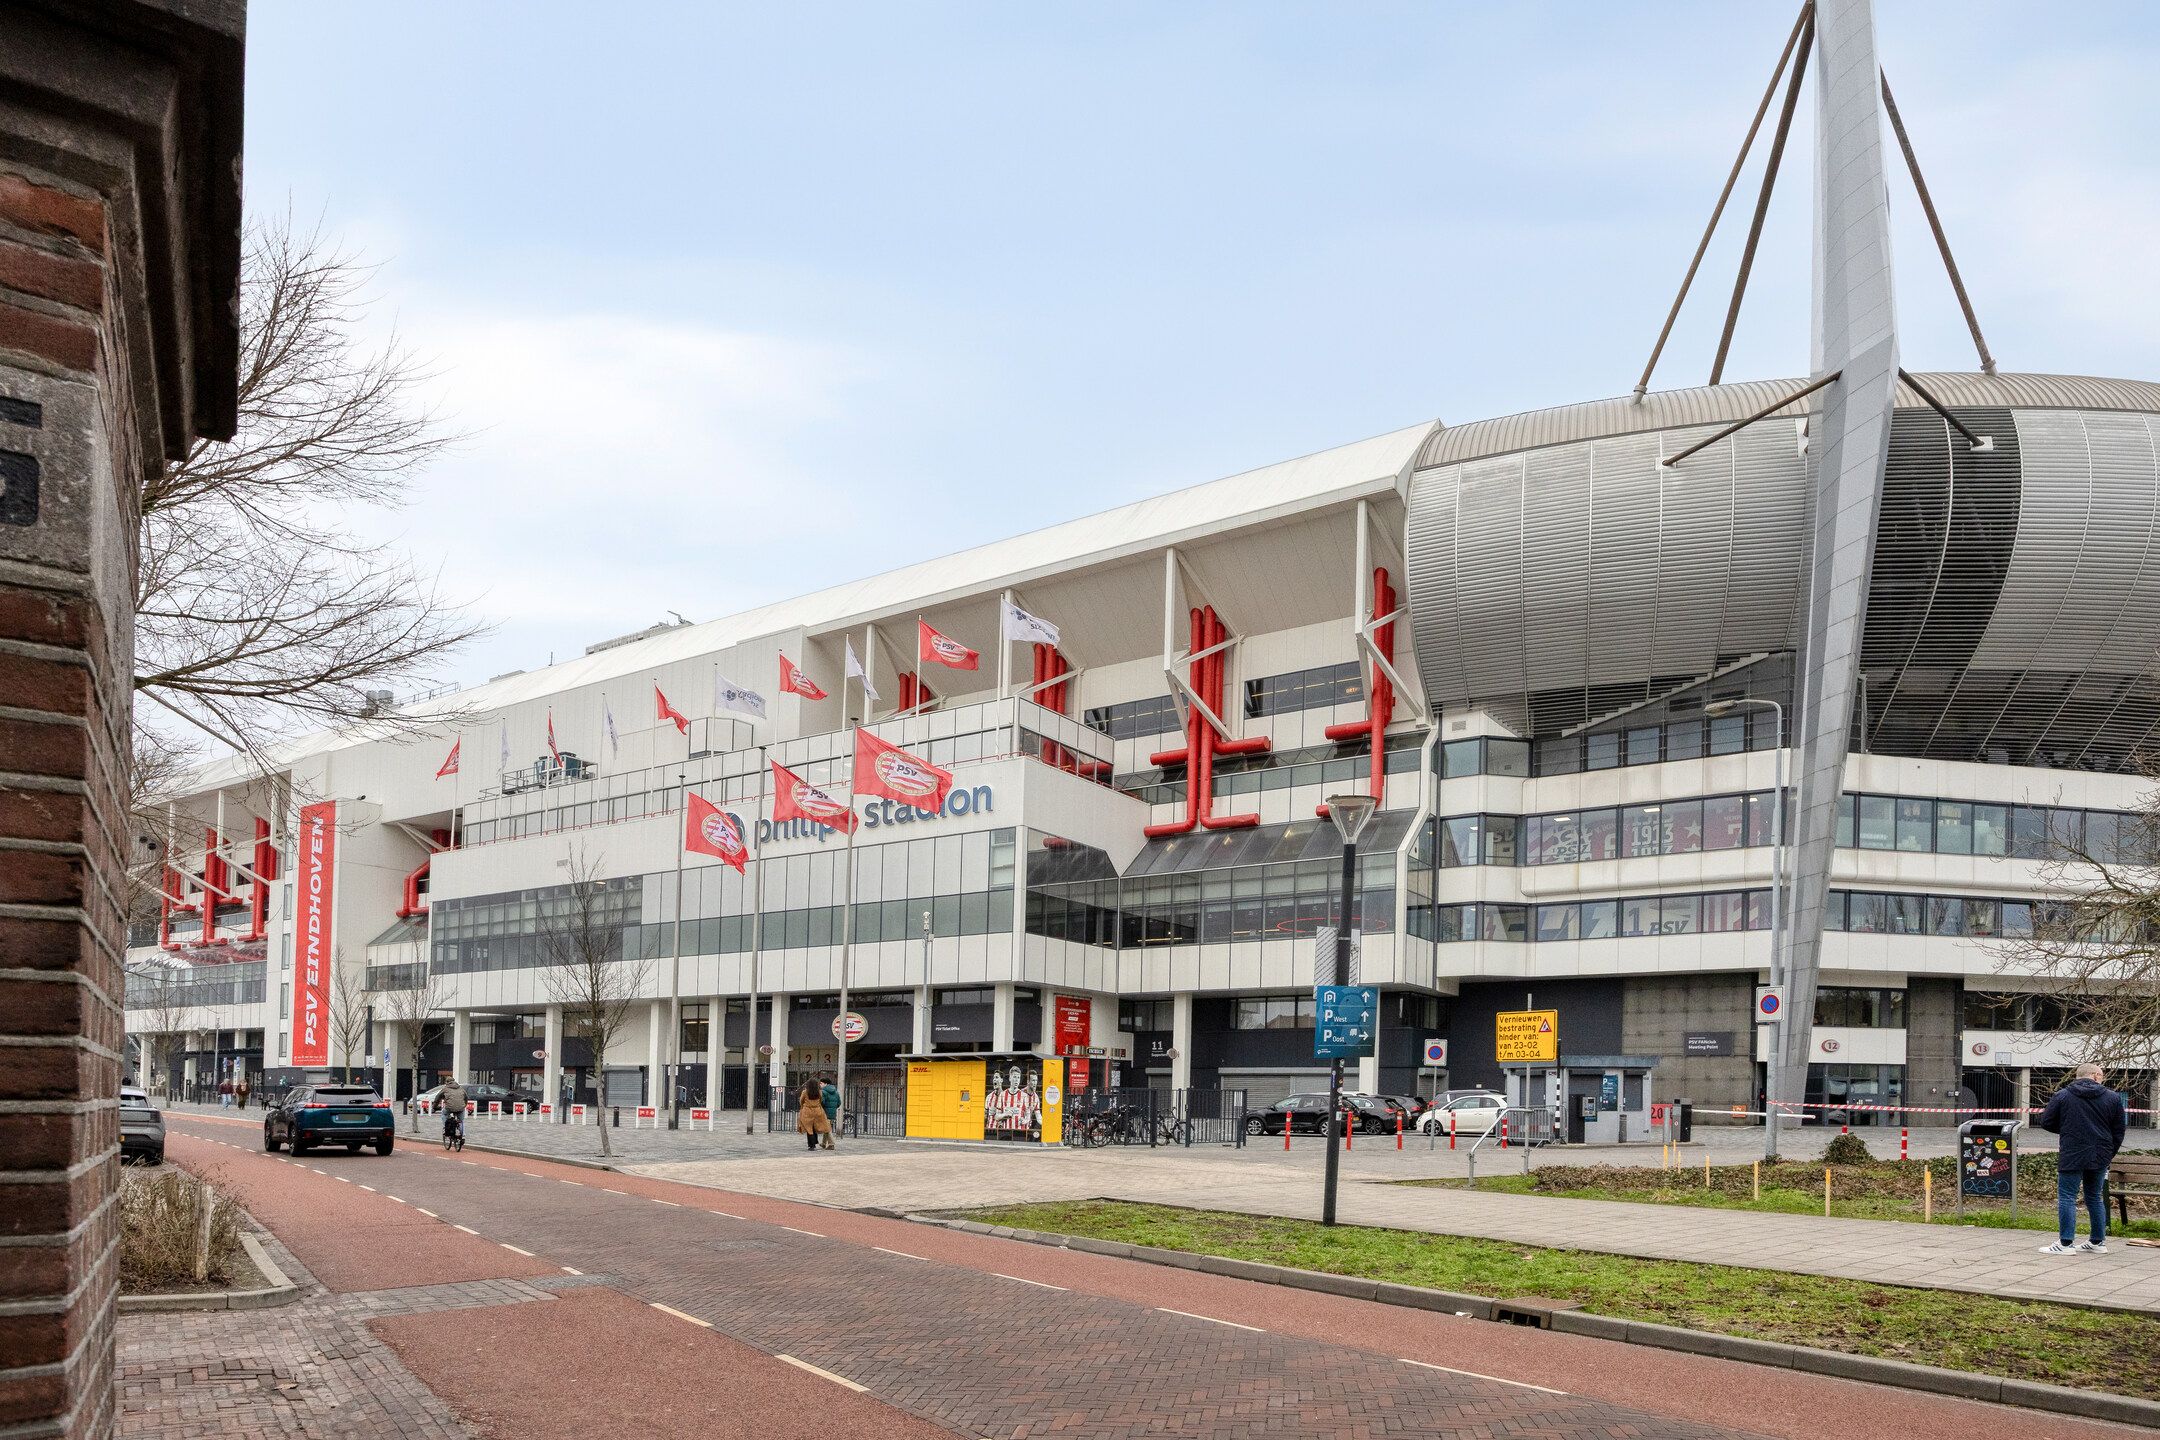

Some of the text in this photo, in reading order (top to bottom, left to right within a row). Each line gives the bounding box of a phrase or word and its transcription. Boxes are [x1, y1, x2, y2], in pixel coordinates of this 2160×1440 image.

[896, 764, 918, 777] PSV
[1631, 823, 1674, 847] 1913
[306, 816, 325, 988] EINDHOVEN
[304, 991, 319, 1046] PSV
[1324, 1009, 1333, 1022] P
[1499, 1015, 1542, 1023] Vernieuwen
[1499, 1023, 1537, 1033] bestrating
[1323, 1029, 1345, 1043] P Oost
[1499, 1033, 1521, 1041] hinder
[1151, 1040, 1163, 1050] 11
[1513, 1041, 1538, 1050] 23-02
[805, 1054, 812, 1064] 2
[824, 1053, 832, 1063] 3
[1499, 1050, 1541, 1058] t/m 03-04
